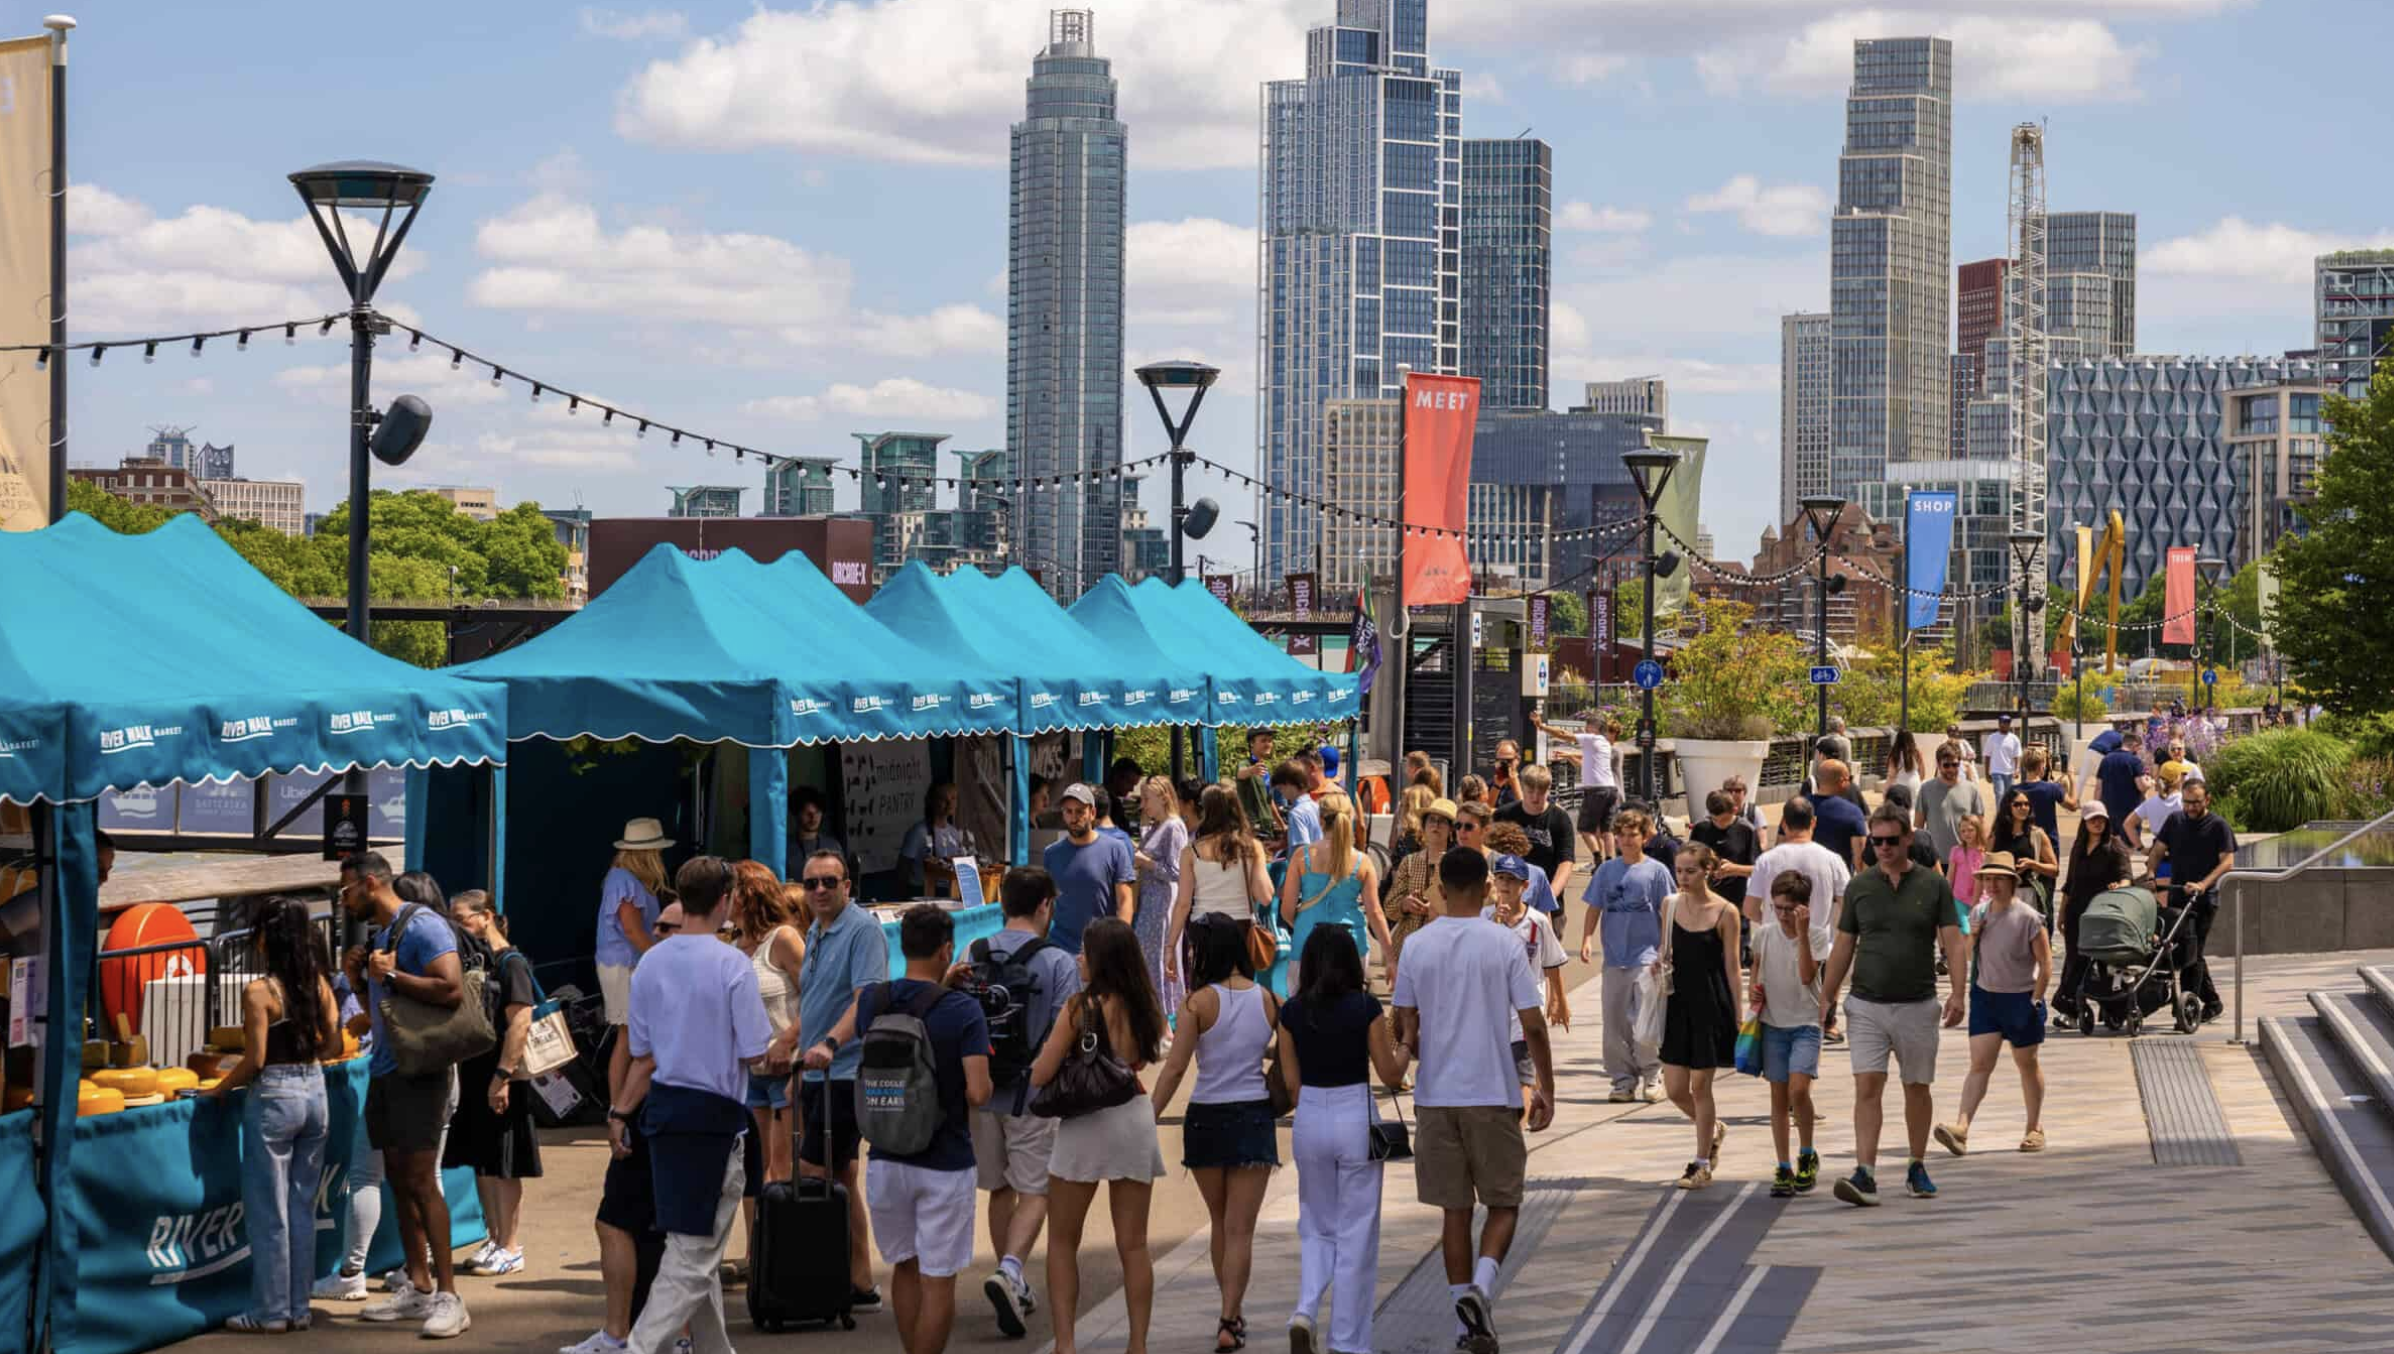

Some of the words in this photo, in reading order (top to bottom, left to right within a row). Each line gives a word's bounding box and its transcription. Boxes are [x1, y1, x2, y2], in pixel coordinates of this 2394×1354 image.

[1415, 389, 1469, 411] MEET
[1914, 500, 1952, 512] SHOP
[832, 561, 867, 585] ARCADE-X
[221, 720, 246, 737] RIVER
[247, 716, 273, 733] WALK
[330, 713, 352, 730] RIVER
[352, 710, 374, 726] WALK
[428, 711, 450, 726] RIVER
[100, 729, 125, 749] RIVER
[125, 724, 153, 744] WALK
[154, 726, 183, 737] MARKET
[879, 793, 917, 817] PANTRY
[147, 1201, 245, 1268] RIVER
